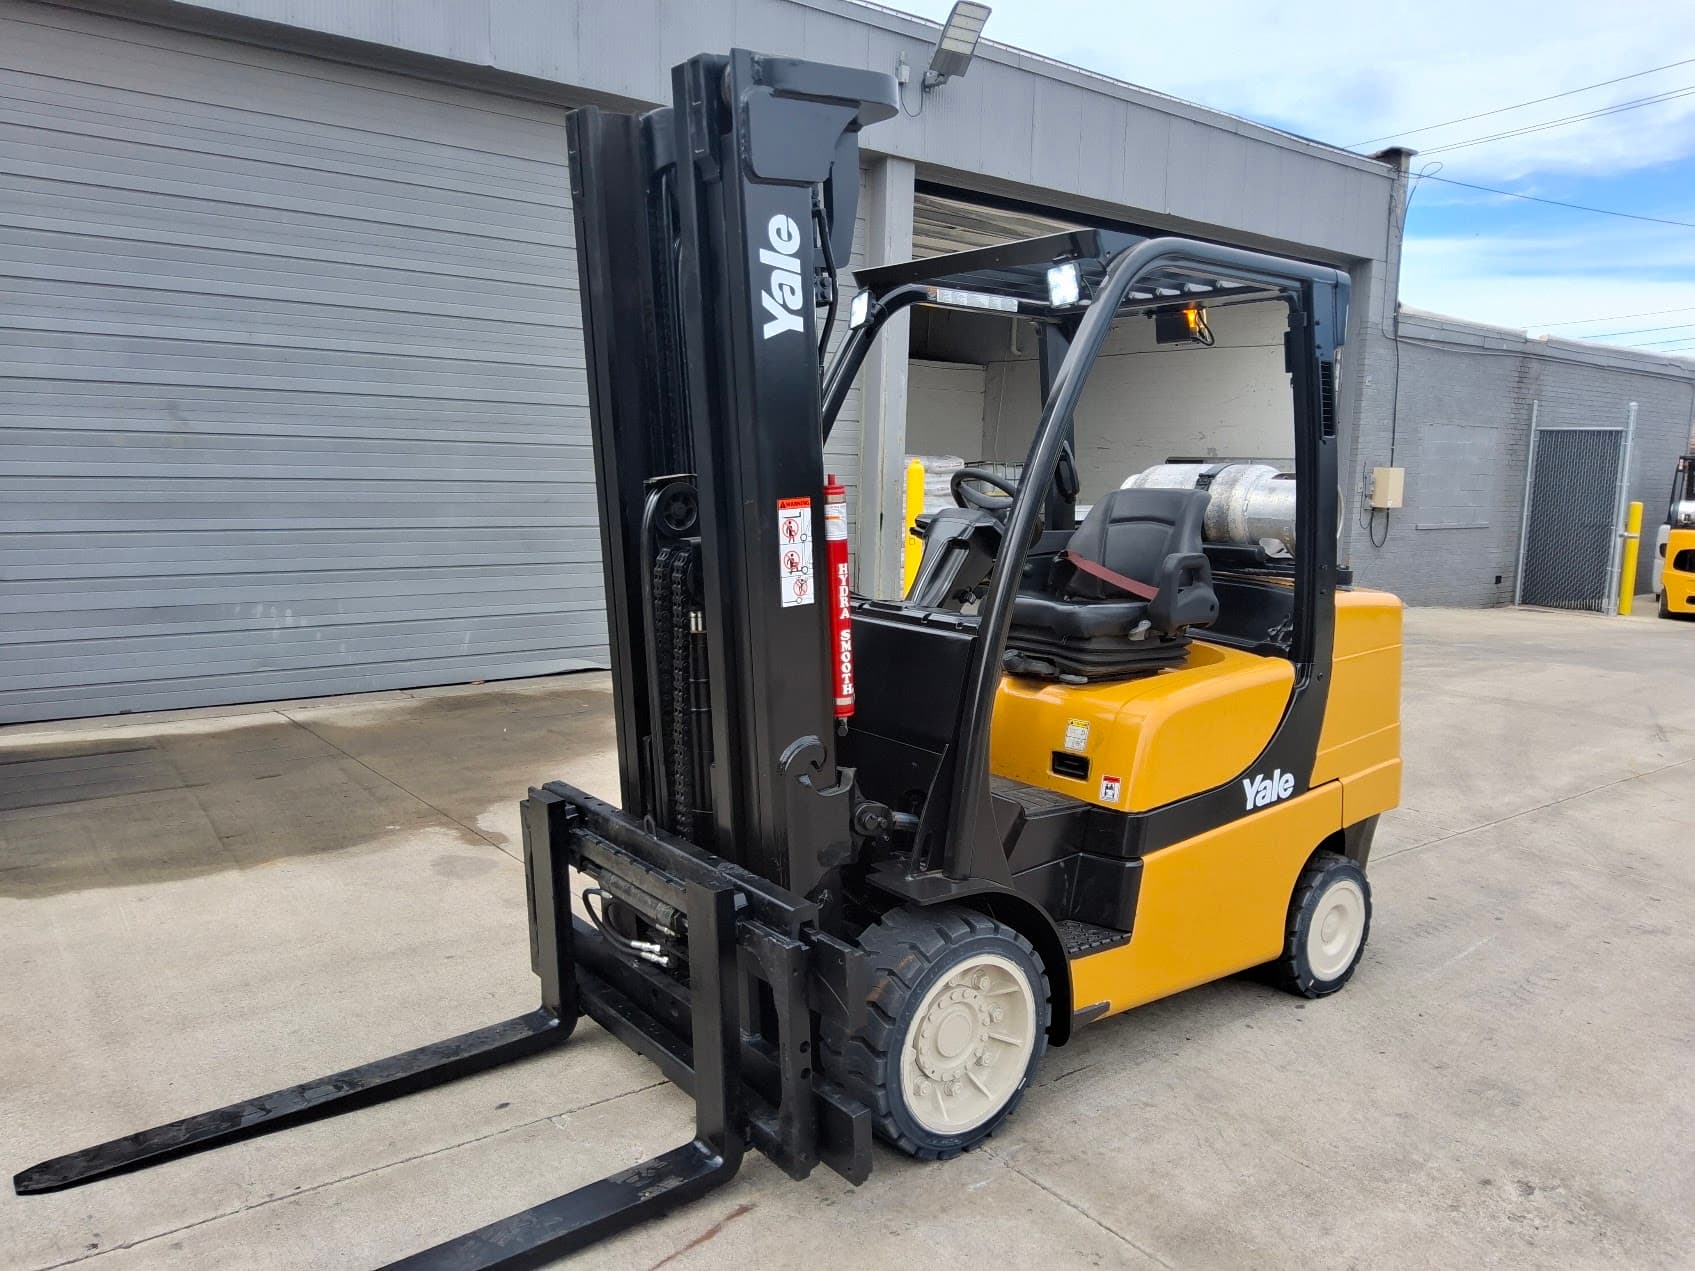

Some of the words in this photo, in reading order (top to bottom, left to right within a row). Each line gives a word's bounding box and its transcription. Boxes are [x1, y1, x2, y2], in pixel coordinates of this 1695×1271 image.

[760, 214, 804, 340] Yale
[838, 563, 850, 619] HYDRA
[840, 629, 853, 695] SMOOTH
[1242, 768, 1295, 811] Yale
